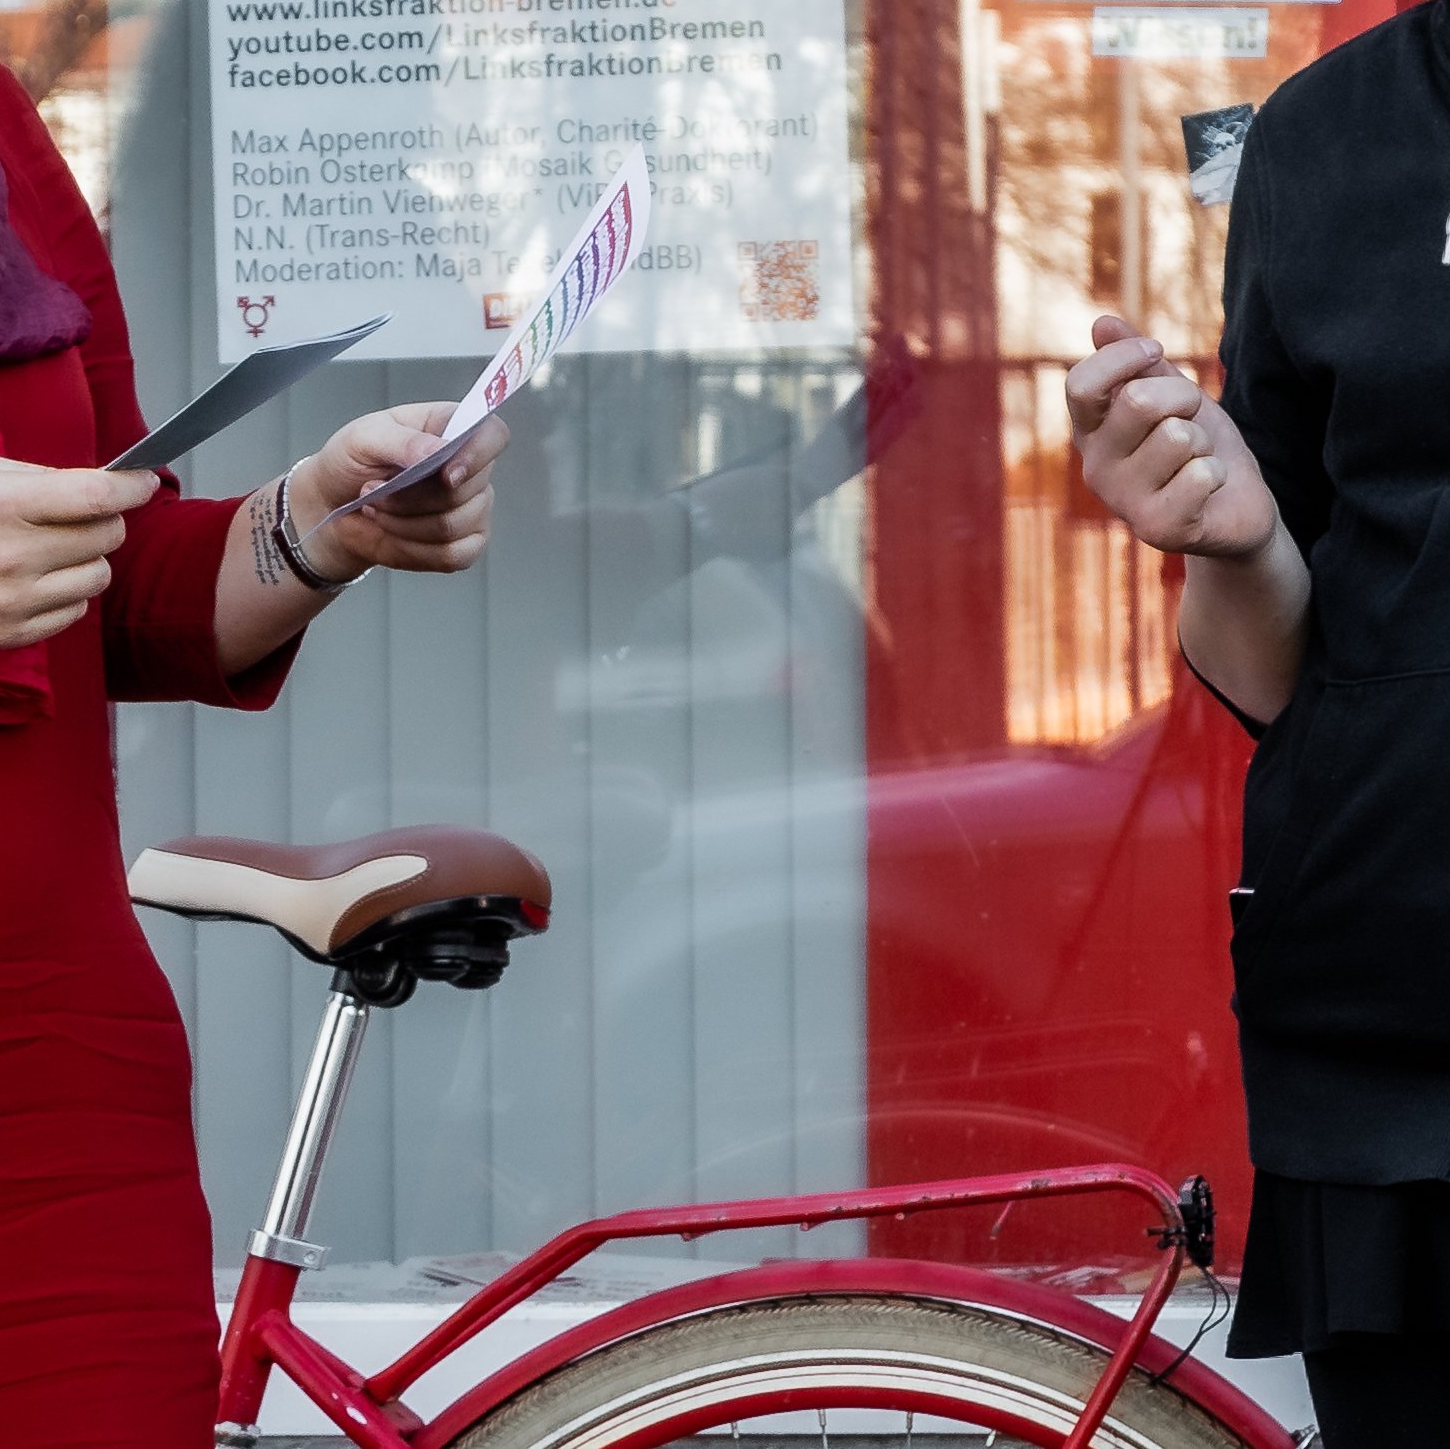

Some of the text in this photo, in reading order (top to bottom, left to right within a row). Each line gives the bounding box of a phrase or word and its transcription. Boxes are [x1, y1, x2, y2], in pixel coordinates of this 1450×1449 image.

[227, 16, 767, 61] youtube.com/LinksfraktionBremen
[231, 129, 287, 156] Max
[299, 124, 444, 160] Appenroth
[232, 160, 310, 187] Robin
[604, 145, 772, 177] Gsundheit)
[233, 192, 272, 219] Dr.
[283, 191, 375, 217] Martin
[233, 219, 490, 255] N.N. (Trans-Recht)
[235, 256, 405, 285] Moderation:
[415, 252, 482, 284] Maja
